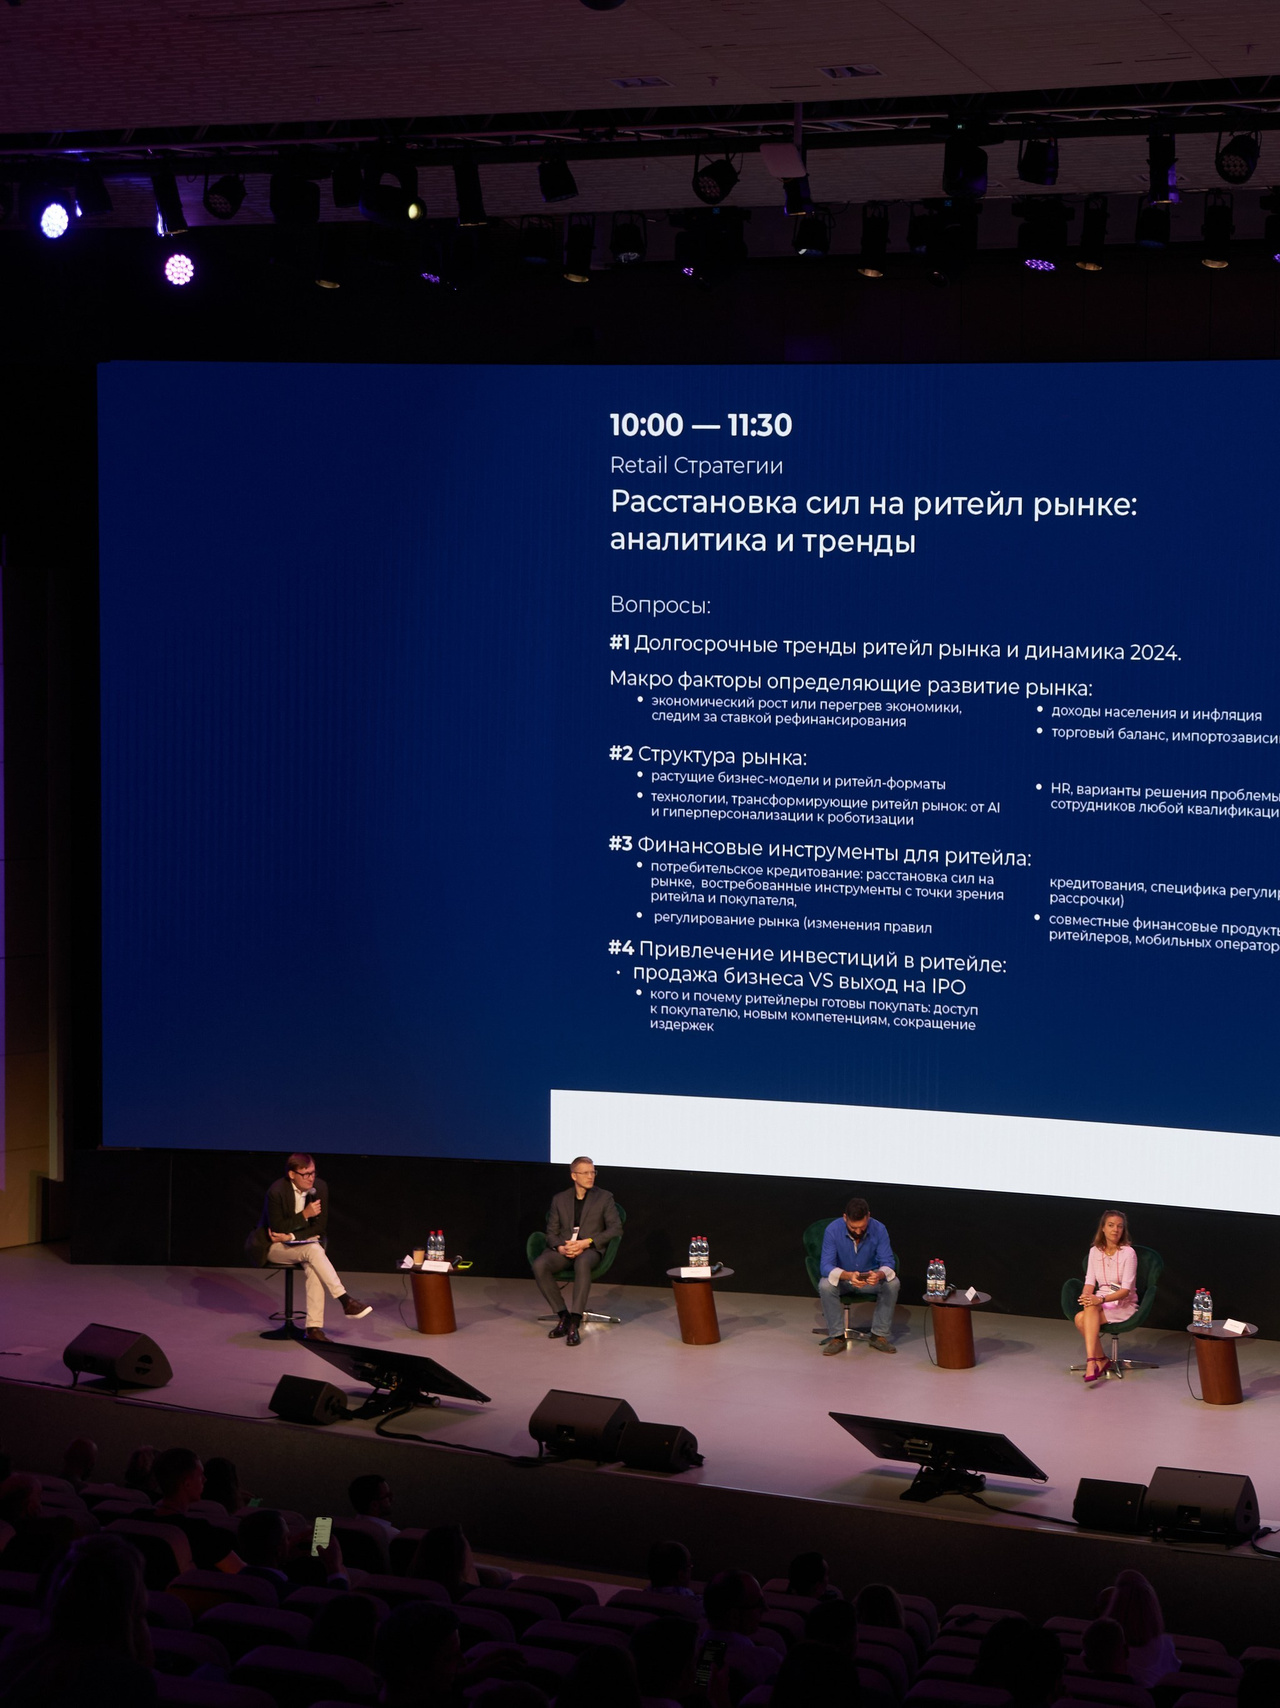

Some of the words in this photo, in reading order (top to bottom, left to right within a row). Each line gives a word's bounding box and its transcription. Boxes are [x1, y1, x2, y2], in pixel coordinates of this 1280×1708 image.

[610, 412, 683, 437] 10:00
[727, 413, 792, 437] 11:30
[611, 455, 667, 474] Retail
[674, 456, 783, 478] Стратегии
[612, 489, 796, 514] Расстановка
[806, 496, 859, 515] сил
[870, 496, 903, 515] на
[914, 490, 1022, 521] ритейл
[1034, 497, 1137, 522] рынке:
[610, 532, 766, 551] аналитика
[777, 533, 793, 552] и
[802, 534, 915, 558] тренды
[611, 595, 710, 617] Вопросы:
[609, 634, 629, 650] #1
[634, 634, 778, 655] Долгосрочные
[783, 640, 856, 657] тренды
[863, 639, 932, 658] ритейл
[939, 643, 1000, 660] рынка
[1007, 645, 1018, 658] и
[1024, 645, 1124, 660] динамика
[1130, 644, 1181, 661] 2024.
[610, 670, 673, 690] Макро
[678, 671, 761, 692] факторы
[767, 676, 921, 694] определяющие
[928, 680, 1020, 696] развитие
[1026, 682, 1092, 699] рынка:
[652, 697, 754, 708] экономический
[758, 699, 788, 710] рост
[791, 700, 816, 709] или
[820, 701, 882, 713] перегрев
[886, 702, 962, 714] экономики,
[1051, 706, 1101, 718] доходы
[1105, 708, 1176, 719] населения
[1180, 710, 1189, 719] и
[1192, 708, 1262, 723] инфляция
[652, 712, 700, 723] следим
[704, 713, 717, 722] за
[720, 712, 771, 723] ставкой
[775, 712, 906, 728] рефинансирования
[1051, 728, 1114, 740] торговый
[1118, 727, 1169, 742] баланс,
[609, 745, 633, 761] #2
[638, 746, 735, 767] Структура
[742, 752, 807, 768] рынка:
[651, 772, 715, 784] растущие
[718, 771, 819, 787] бизнес-модели
[823, 777, 831, 786] и
[835, 776, 946, 791] ритейл-форматы
[1051, 782, 1073, 796] HR,
[1077, 785, 1141, 797] варианты
[1145, 788, 1207, 799] решения
[1211, 788, 1280, 802] проблемы
[608, 835, 633, 851] #3
[638, 836, 763, 856] Финансовые
[769, 844, 898, 862] инструменты
[903, 849, 939, 864] для
[945, 849, 1031, 867] ритейла:
[651, 861, 763, 875] потребительское
[767, 867, 863, 879] кредитование:
[866, 871, 947, 883] расстановка
[951, 874, 975, 884] сил
[979, 875, 994, 885] на
[1049, 915, 1129, 928] совместные
[1132, 917, 1218, 933] финансовые
[1049, 930, 1132, 945] ритейлеров,
[1135, 933, 1212, 948] мобильных
[608, 939, 635, 956] #4
[640, 940, 774, 961] Привлечение
[780, 949, 897, 969] инвестиций
[904, 955, 914, 968] в
[920, 955, 1006, 973] ритейле:
[634, 967, 717, 984] продажа
[724, 967, 803, 987] бизнеса
[809, 972, 833, 988] VS
[839, 976, 898, 994] выход
[904, 979, 925, 993] на
[933, 978, 966, 995] IPO
